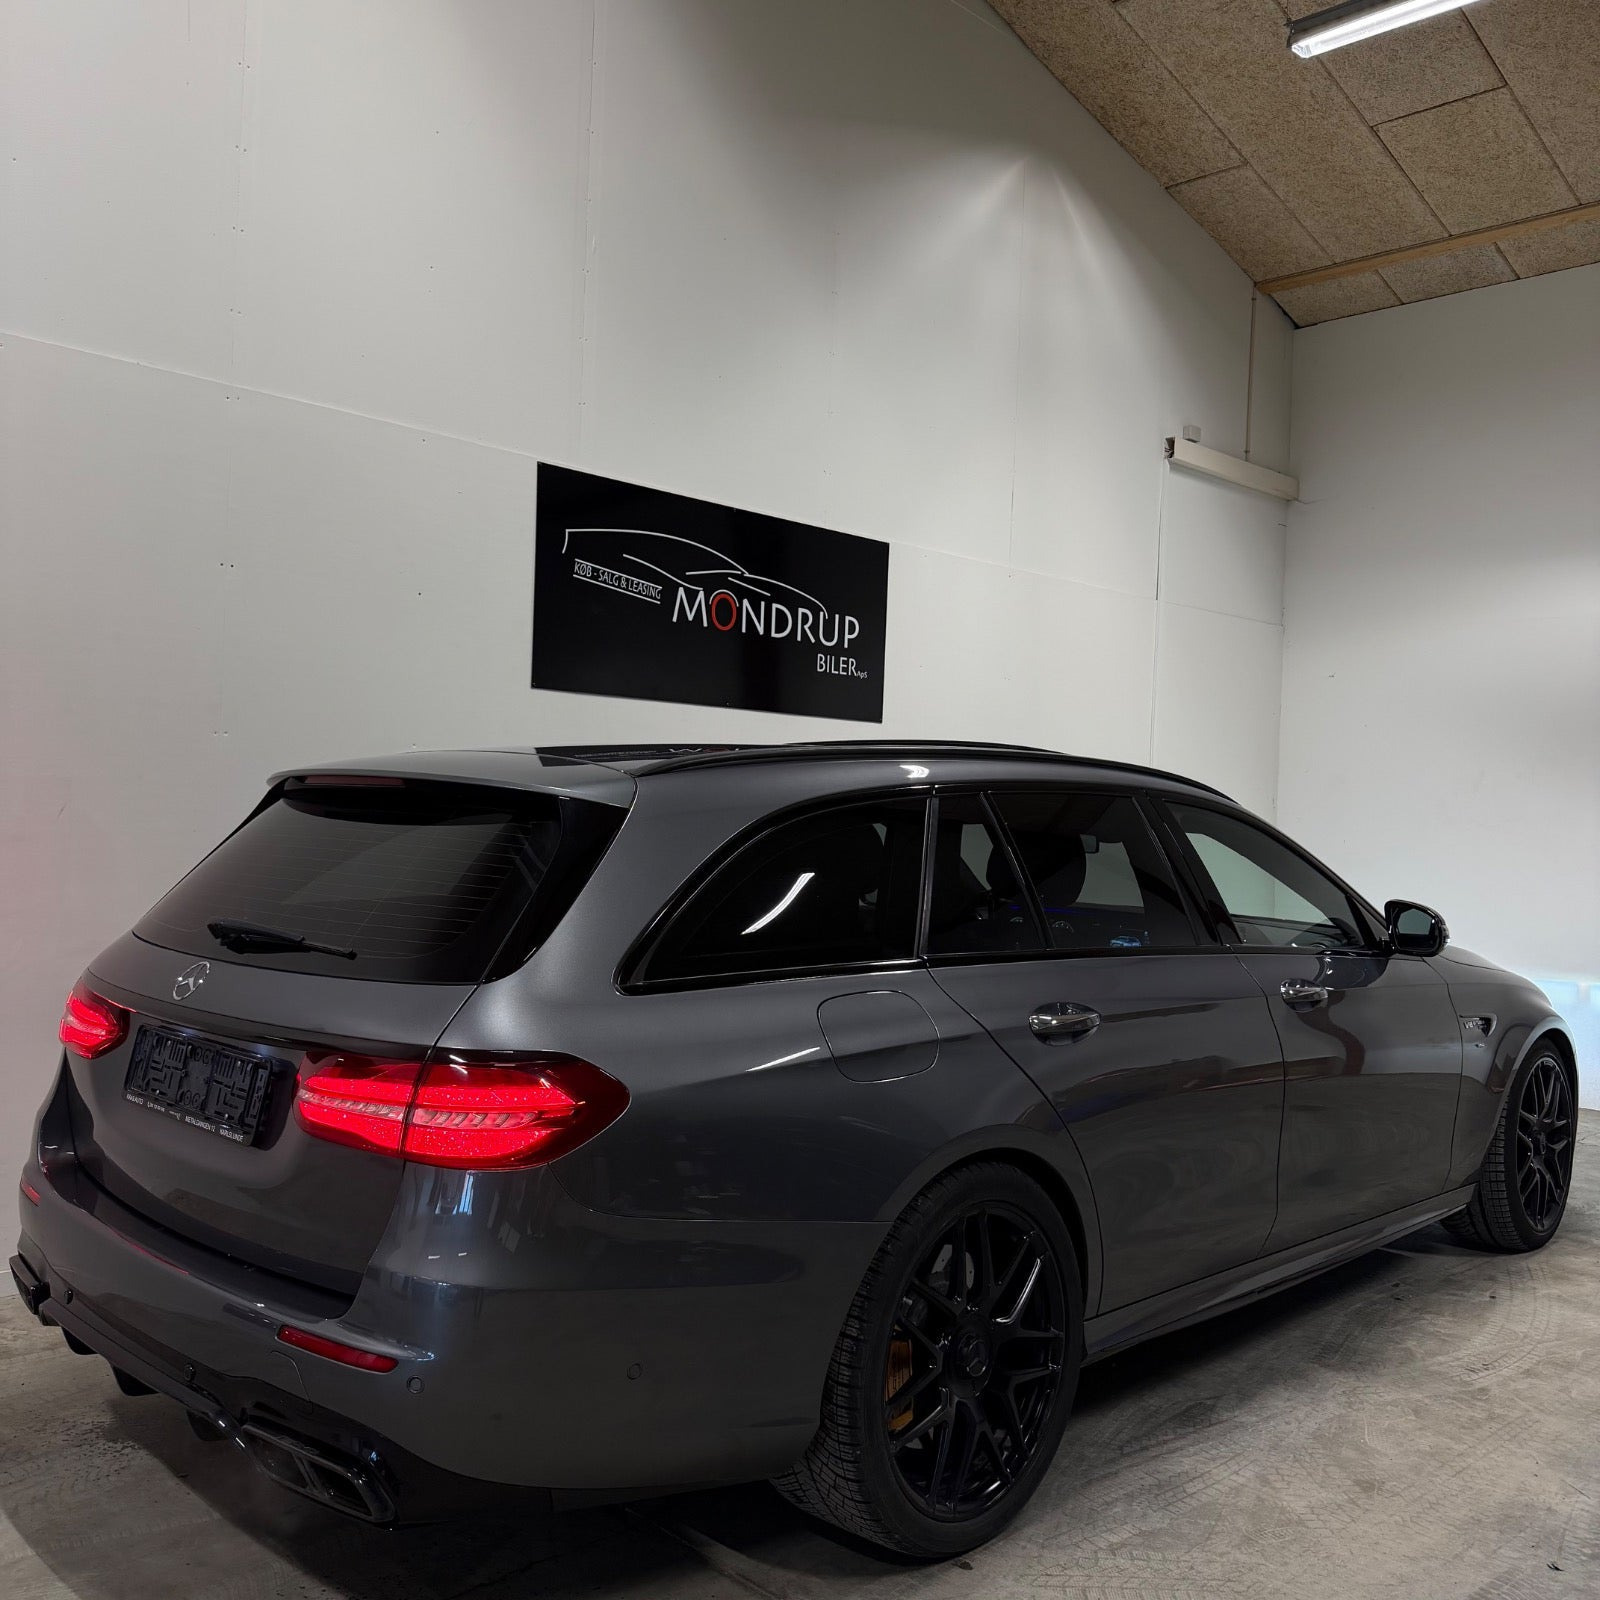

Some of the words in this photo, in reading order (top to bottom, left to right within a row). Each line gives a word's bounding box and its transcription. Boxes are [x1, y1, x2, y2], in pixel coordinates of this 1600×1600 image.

[573, 561, 592, 577] KØB
[598, 569, 619, 586] SALG
[620, 576, 627, 588] &
[628, 579, 661, 600] LEASING
[672, 586, 860, 648] MONDRUP
[816, 653, 857, 677] BILER
